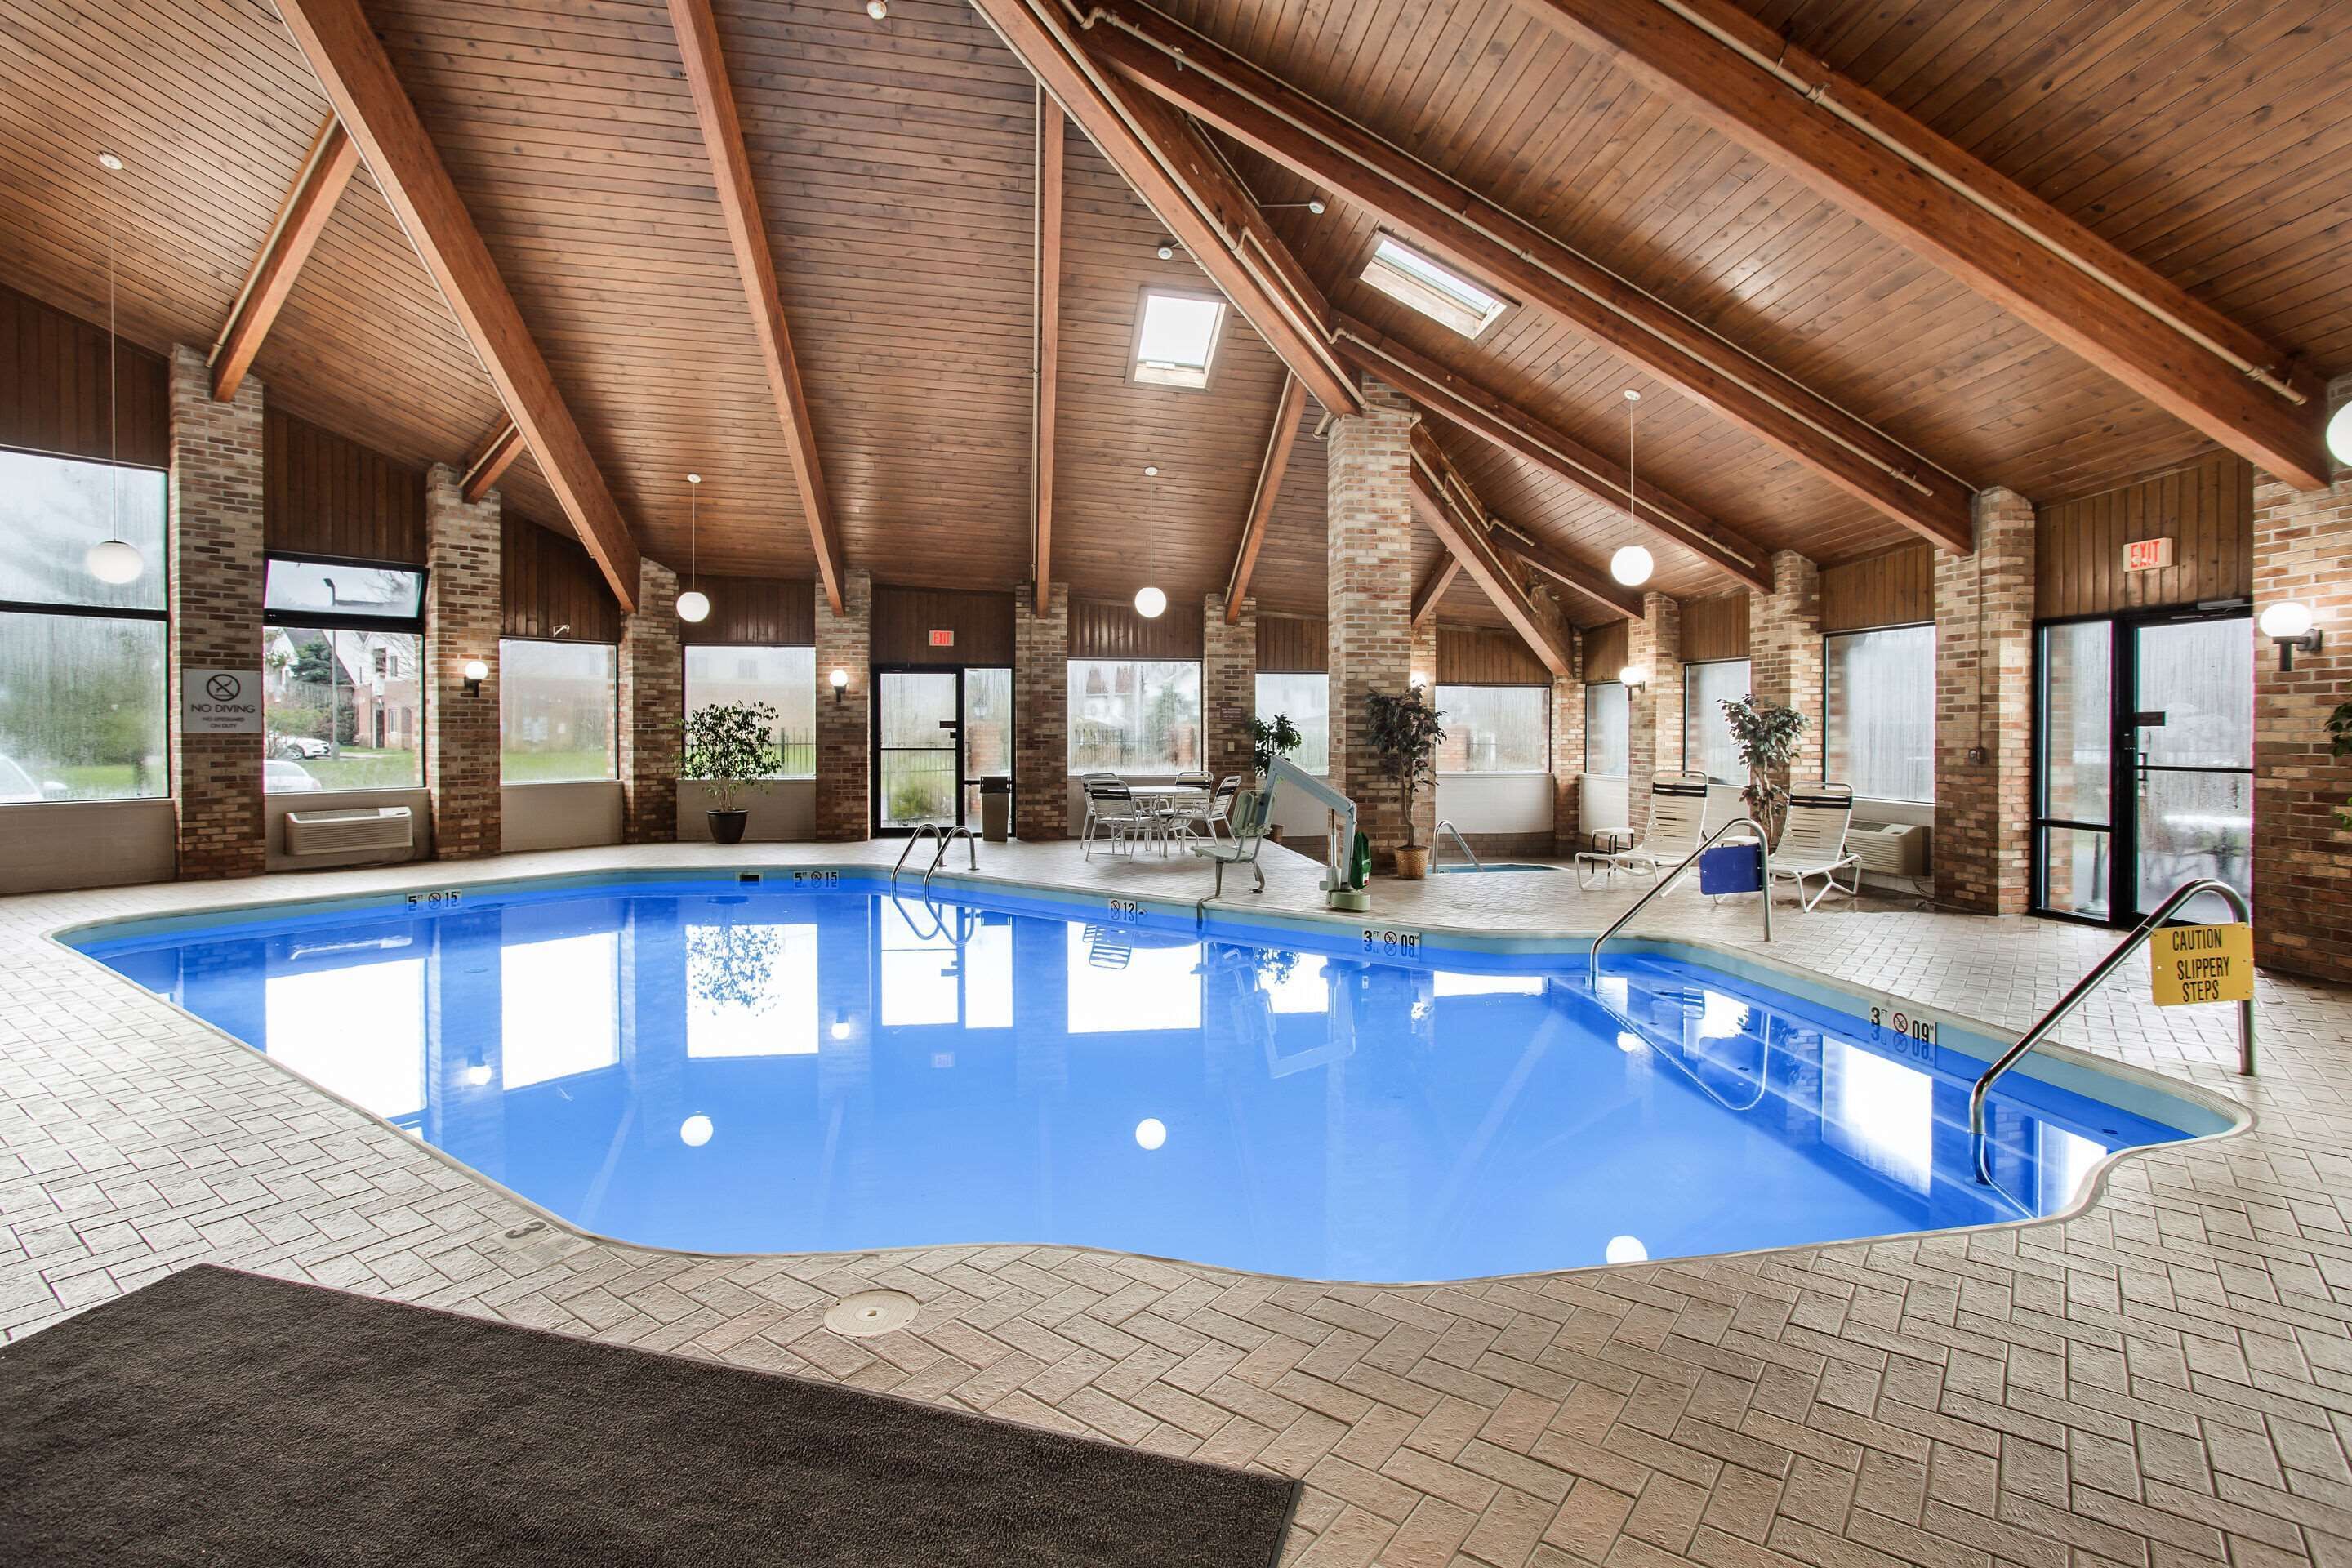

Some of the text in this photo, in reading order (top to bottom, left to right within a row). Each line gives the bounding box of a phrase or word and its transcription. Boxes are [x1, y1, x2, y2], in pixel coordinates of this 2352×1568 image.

[2131, 541, 2160, 568] EXIT
[933, 631, 951, 644] EXIT
[191, 704, 256, 713] NO DIVING
[1364, 930, 1373, 943] 3
[2172, 928, 2222, 951] CAUTION
[2176, 956, 2230, 981] SLIPPERY
[2182, 979, 2220, 1003] STEPS
[1871, 1007, 1880, 1027] 3
[505, 1222, 547, 1239] 3
